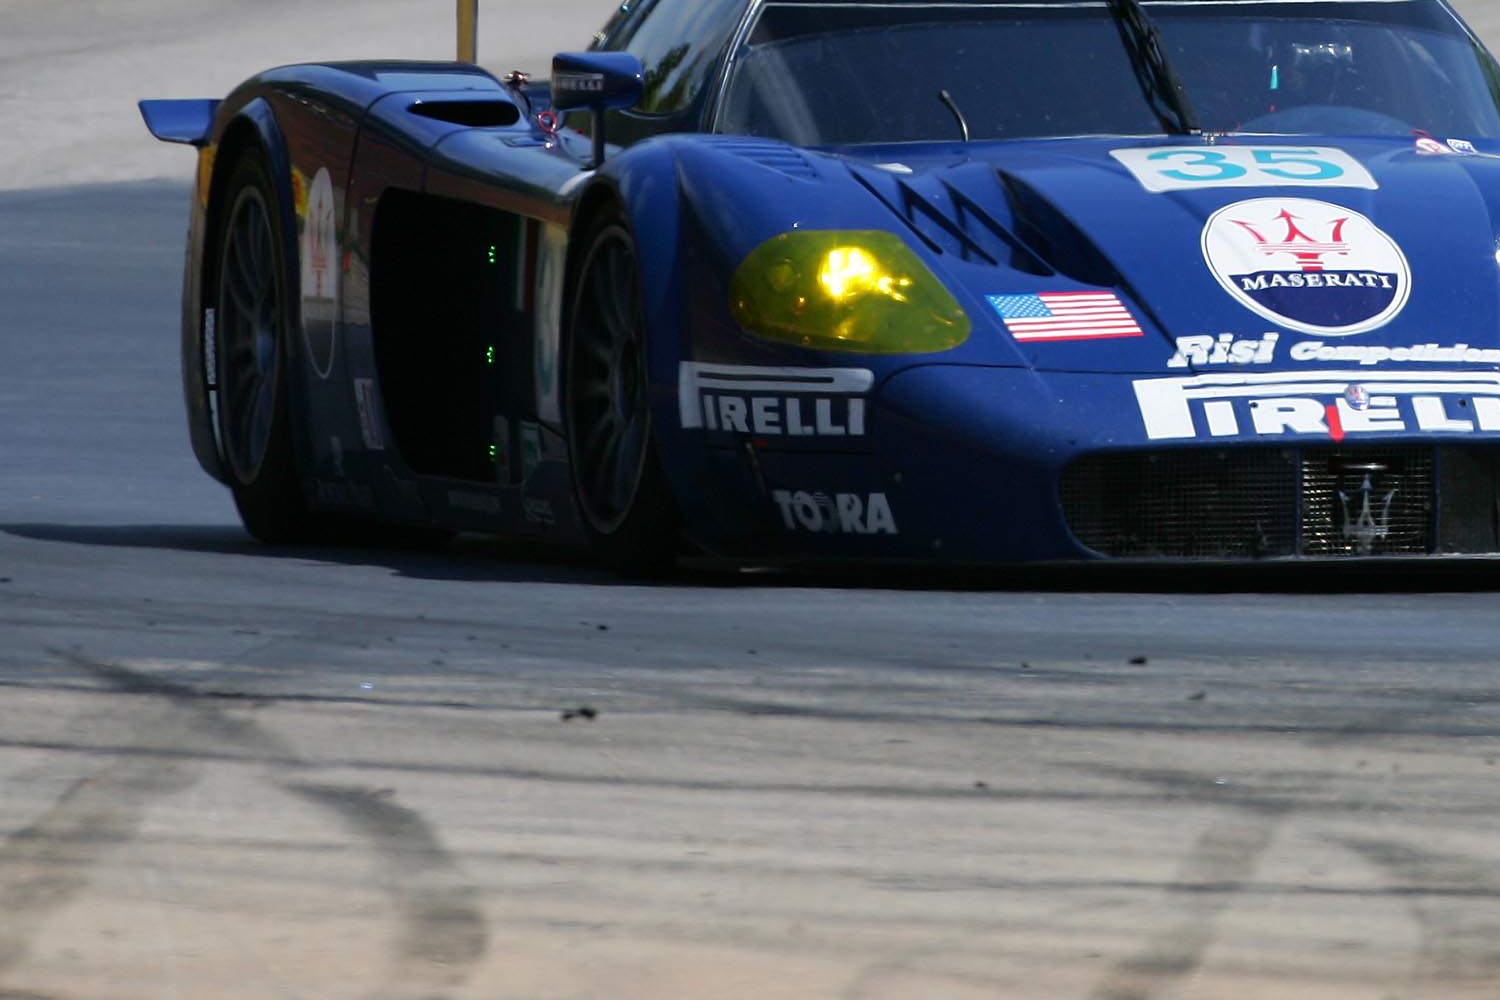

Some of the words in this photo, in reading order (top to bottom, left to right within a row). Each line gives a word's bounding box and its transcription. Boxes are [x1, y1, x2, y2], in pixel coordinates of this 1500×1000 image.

[1146, 149, 1345, 182] 35
[1241, 272, 1393, 292] MASERATI
[1166, 331, 1280, 369] Risi
[678, 360, 875, 436] PIRELLI
